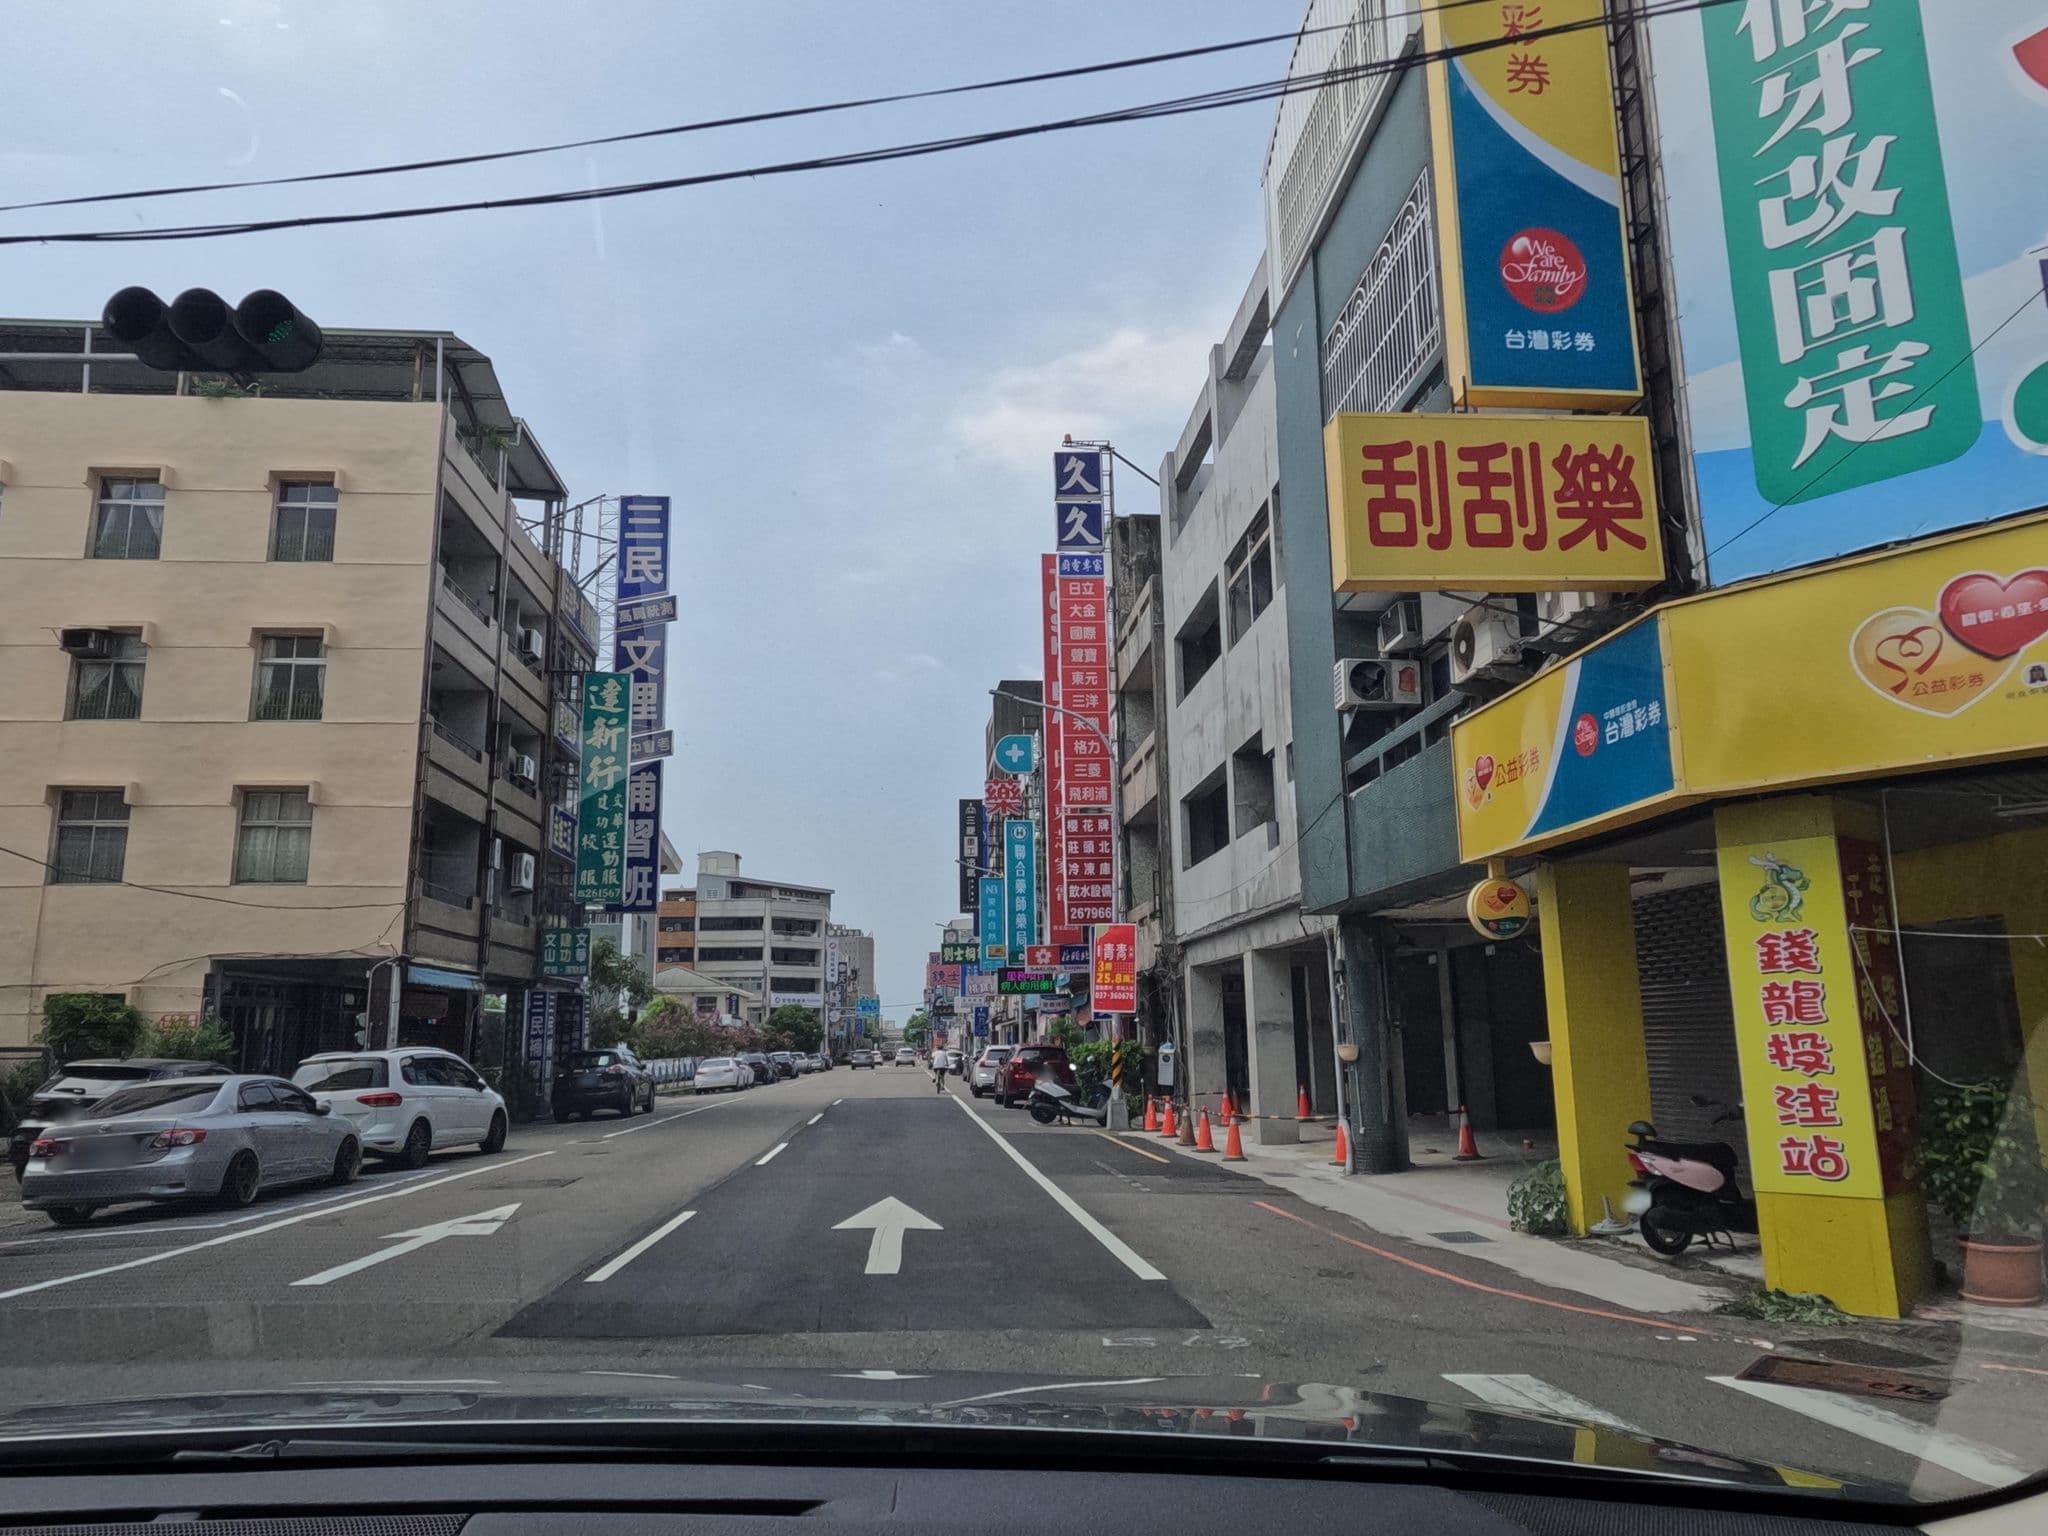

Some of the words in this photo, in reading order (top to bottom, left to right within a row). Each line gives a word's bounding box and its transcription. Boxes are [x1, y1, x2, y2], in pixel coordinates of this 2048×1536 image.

[1527, 239, 1555, 257] We
[1540, 253, 1565, 268] are
[1502, 254, 1586, 295] Family
[1504, 328, 1596, 352] 台灣彩券
[1059, 455, 1101, 545] 久久
[1361, 439, 1648, 553] 刮刮樂
[1069, 582, 1095, 596] 日立
[1069, 604, 1096, 618] 大金
[1069, 626, 1097, 641] 國際
[1071, 671, 1099, 686] 東元
[1912, 671, 1984, 697] 公益彩券
[1072, 694, 1099, 708] 三洋
[1604, 700, 1661, 745] 台灣彩券
[1074, 740, 1101, 755] 格力
[1495, 746, 1540, 788] 公益彩券
[1069, 786, 1108, 801] 飛利浦
[1067, 819, 1109, 832] 櫻花牌
[1068, 840, 1110, 854] 莊頭北
[1069, 885, 1112, 898] 飲水設備
[1070, 907, 1112, 919] 267966
[1755, 928, 1847, 1179] 錢龍投注站
